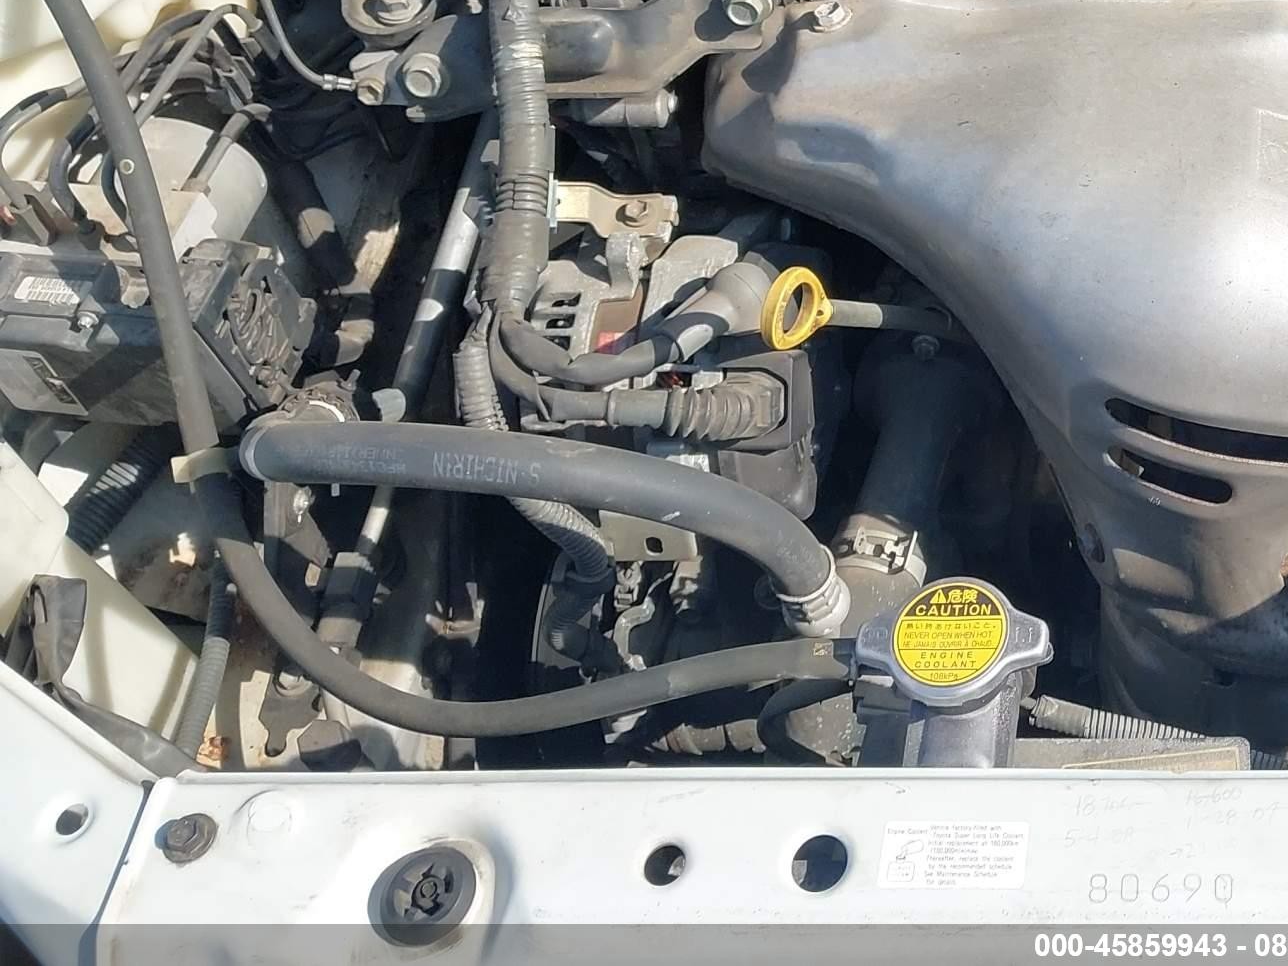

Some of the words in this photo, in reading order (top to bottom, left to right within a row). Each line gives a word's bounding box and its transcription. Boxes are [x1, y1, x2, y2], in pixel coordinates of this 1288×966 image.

[947, 589, 978, 604] 危険
[915, 604, 992, 616] CAUTION
[904, 631, 930, 640] NEVER
[931, 631, 952, 640] OPEN
[954, 631, 975, 639] WHEN
[976, 630, 993, 638] HOT
[920, 651, 973, 659] ENGINE
[914, 660, 977, 668] COOLANT
